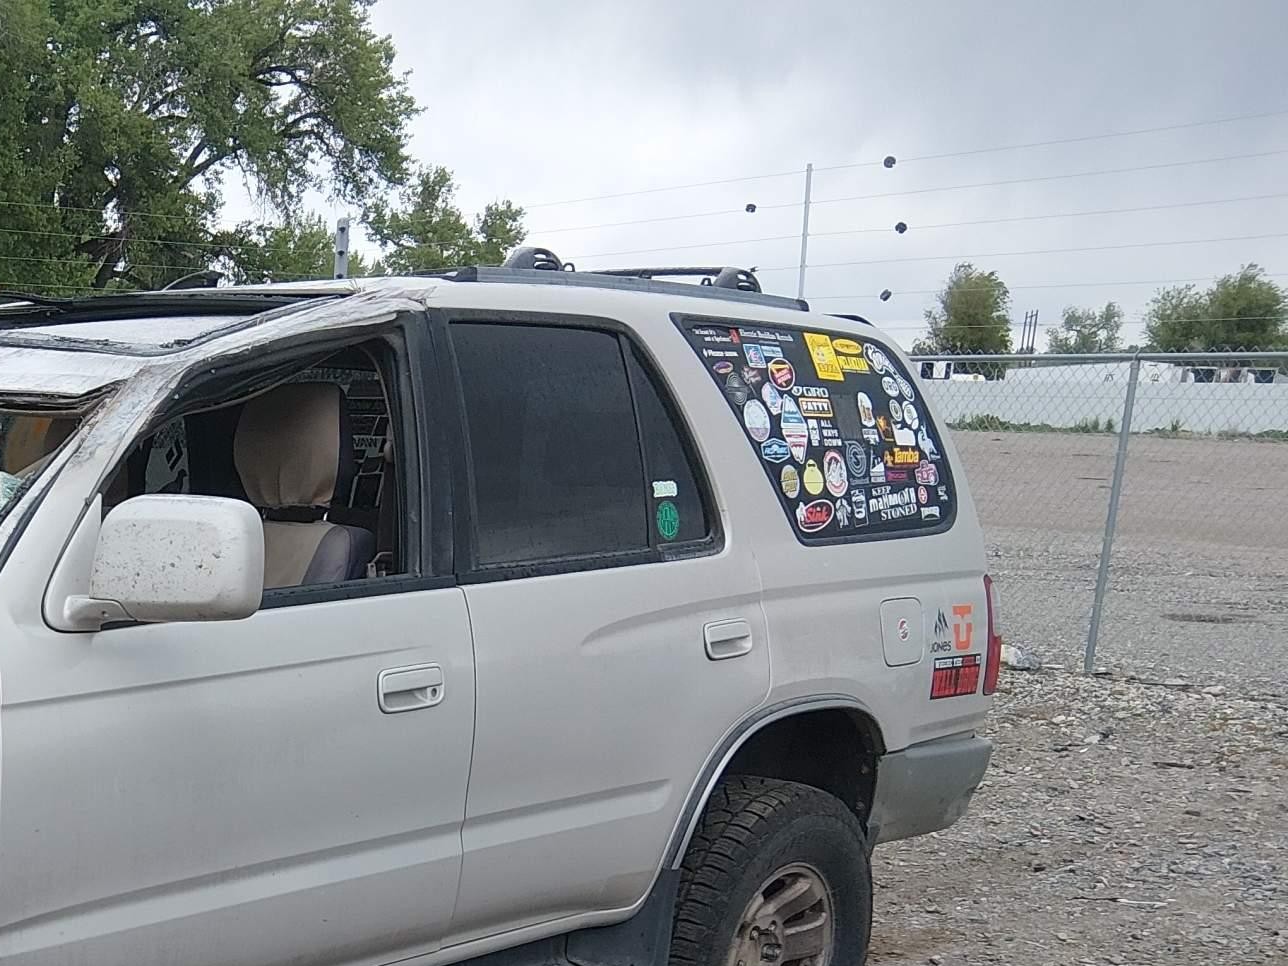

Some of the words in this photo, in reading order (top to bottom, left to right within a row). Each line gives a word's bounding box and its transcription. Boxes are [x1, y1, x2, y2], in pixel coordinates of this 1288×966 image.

[803, 387, 829, 397] GIRO
[802, 401, 829, 410] FATTY
[893, 448, 919, 463] Tamba
[872, 486, 891, 496] KEEP
[881, 503, 918, 520] STONED
